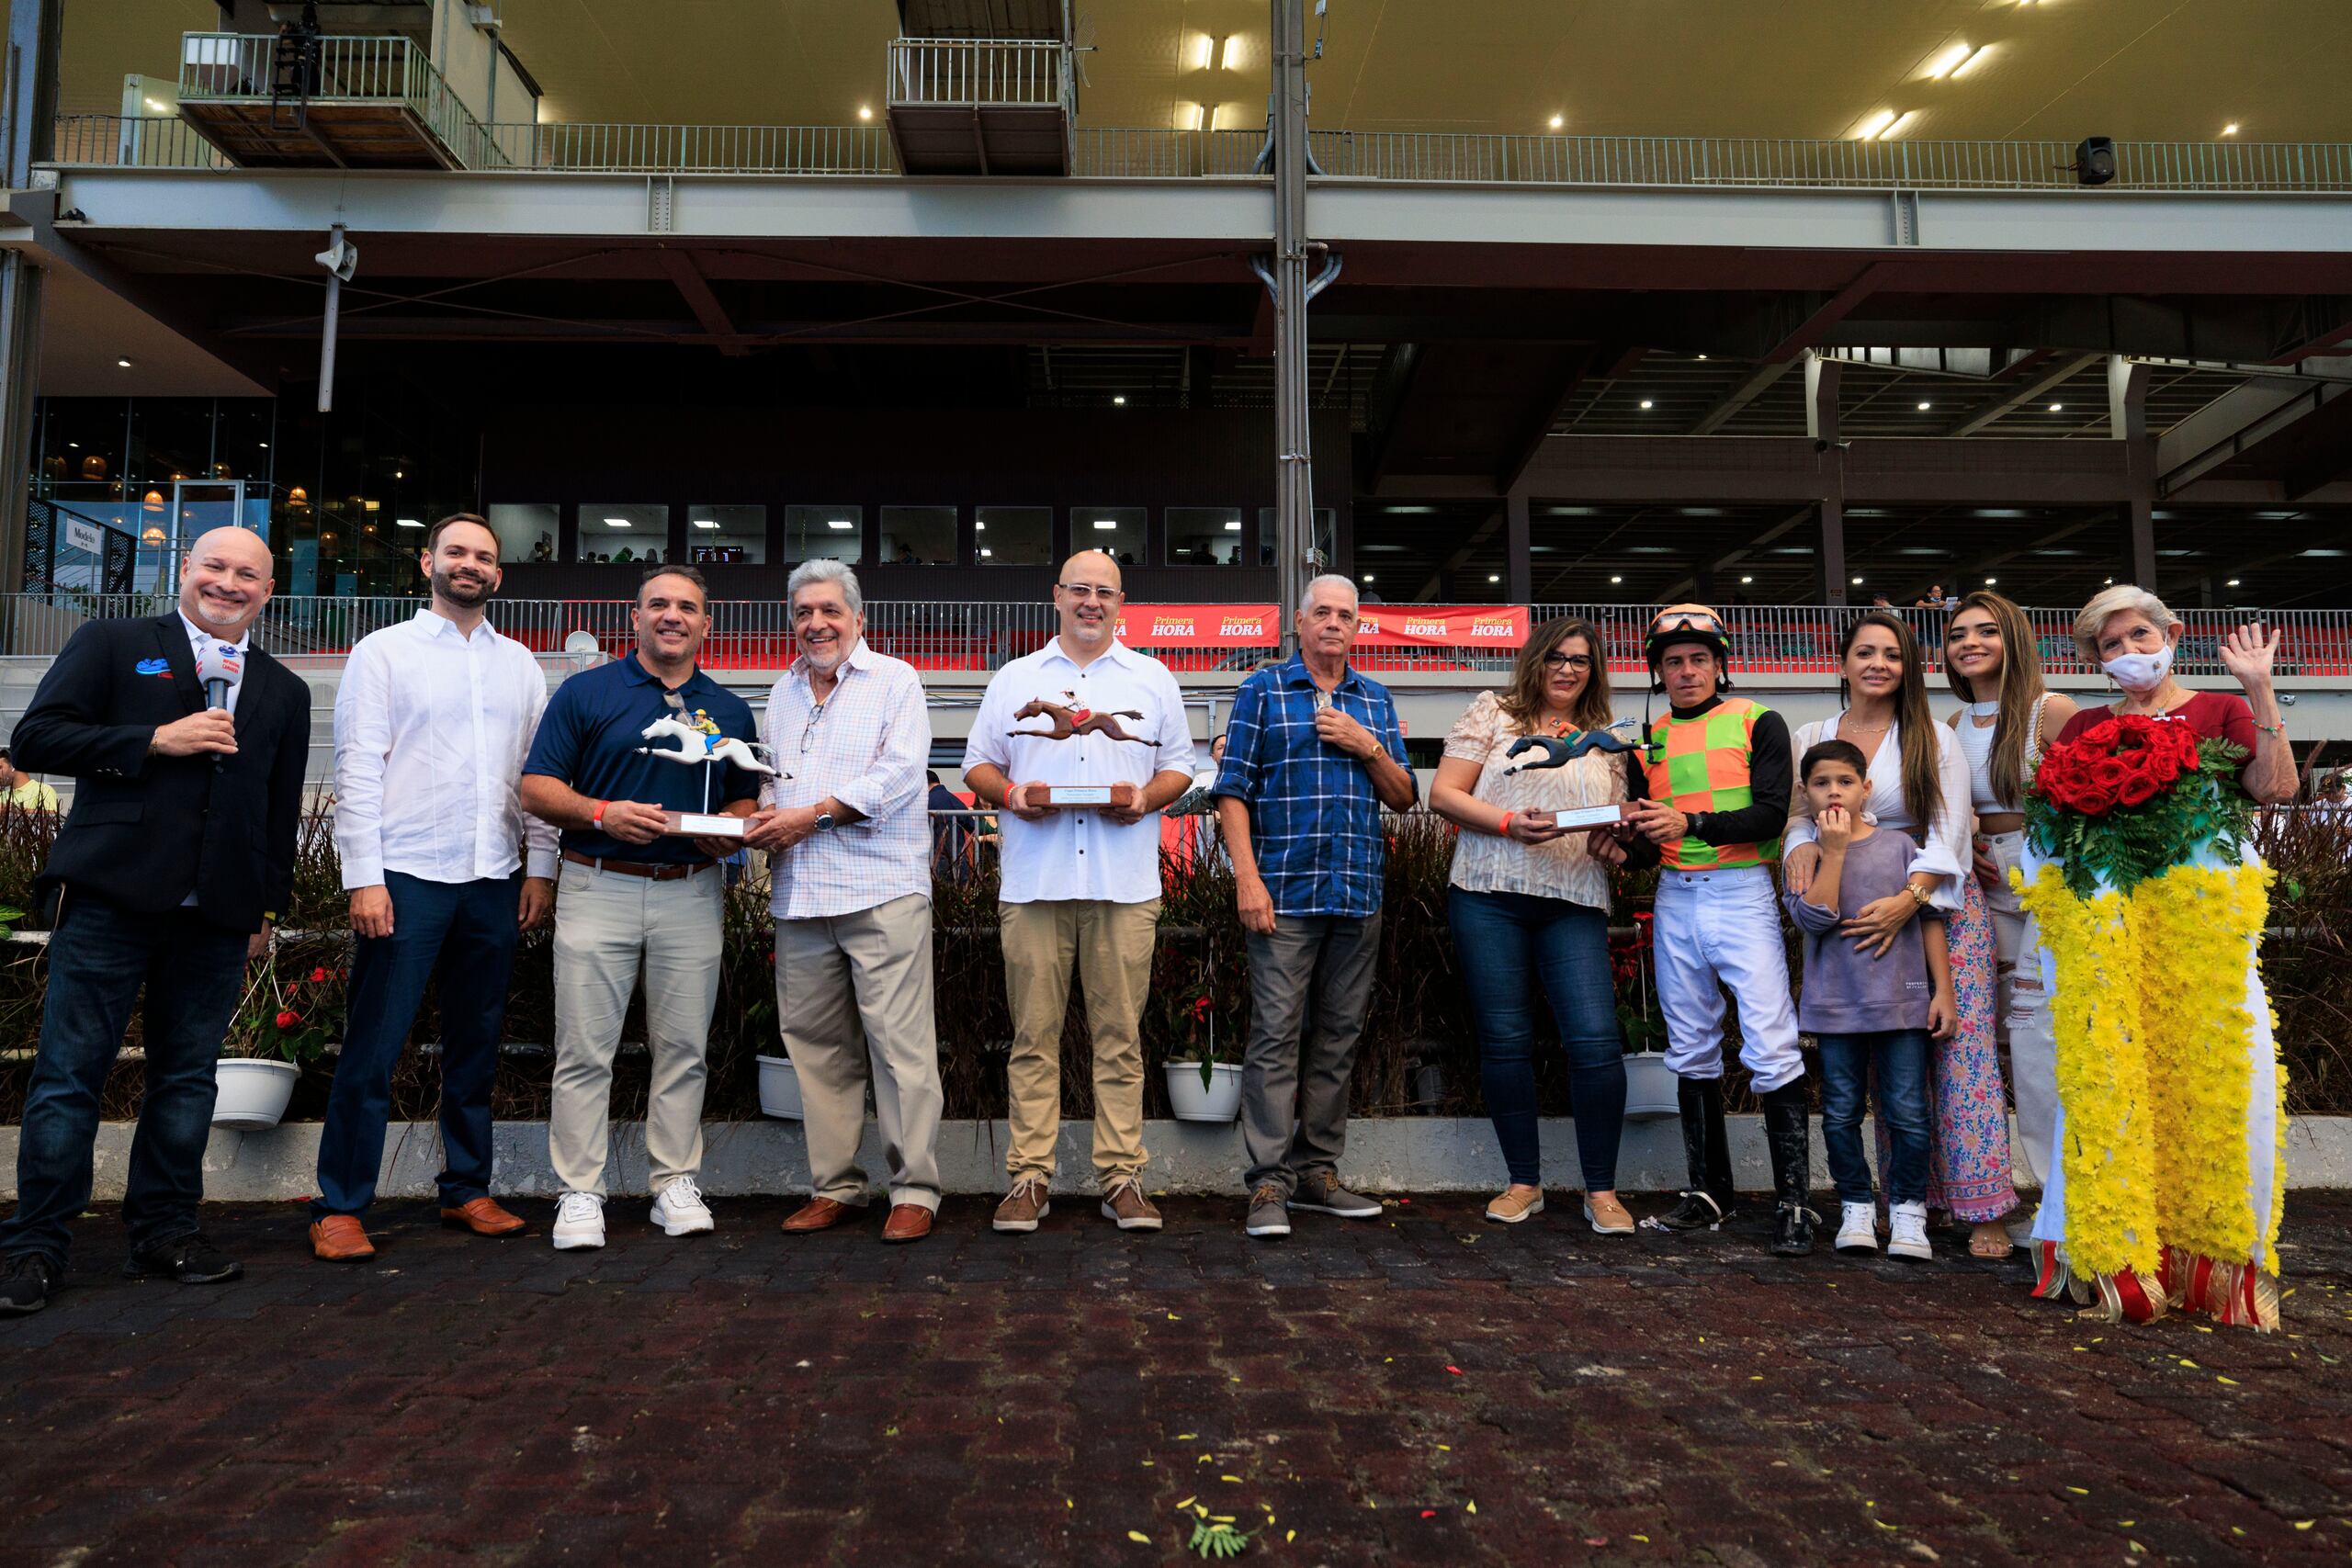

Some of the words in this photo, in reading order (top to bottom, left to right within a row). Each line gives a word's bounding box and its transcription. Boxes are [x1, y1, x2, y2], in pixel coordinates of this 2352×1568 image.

[74, 526, 96, 544] Modelo
[1154, 616, 1194, 625] Primera
[1222, 616, 1262, 625] Primera
[1407, 616, 1445, 626] Primera
[1474, 616, 1513, 626] Primera
[1151, 625, 1195, 636] HORA
[1219, 625, 1262, 636] HORA
[1358, 623, 1380, 634] RA
[1403, 625, 1447, 636] HORA
[1471, 625, 1514, 637] HORA
